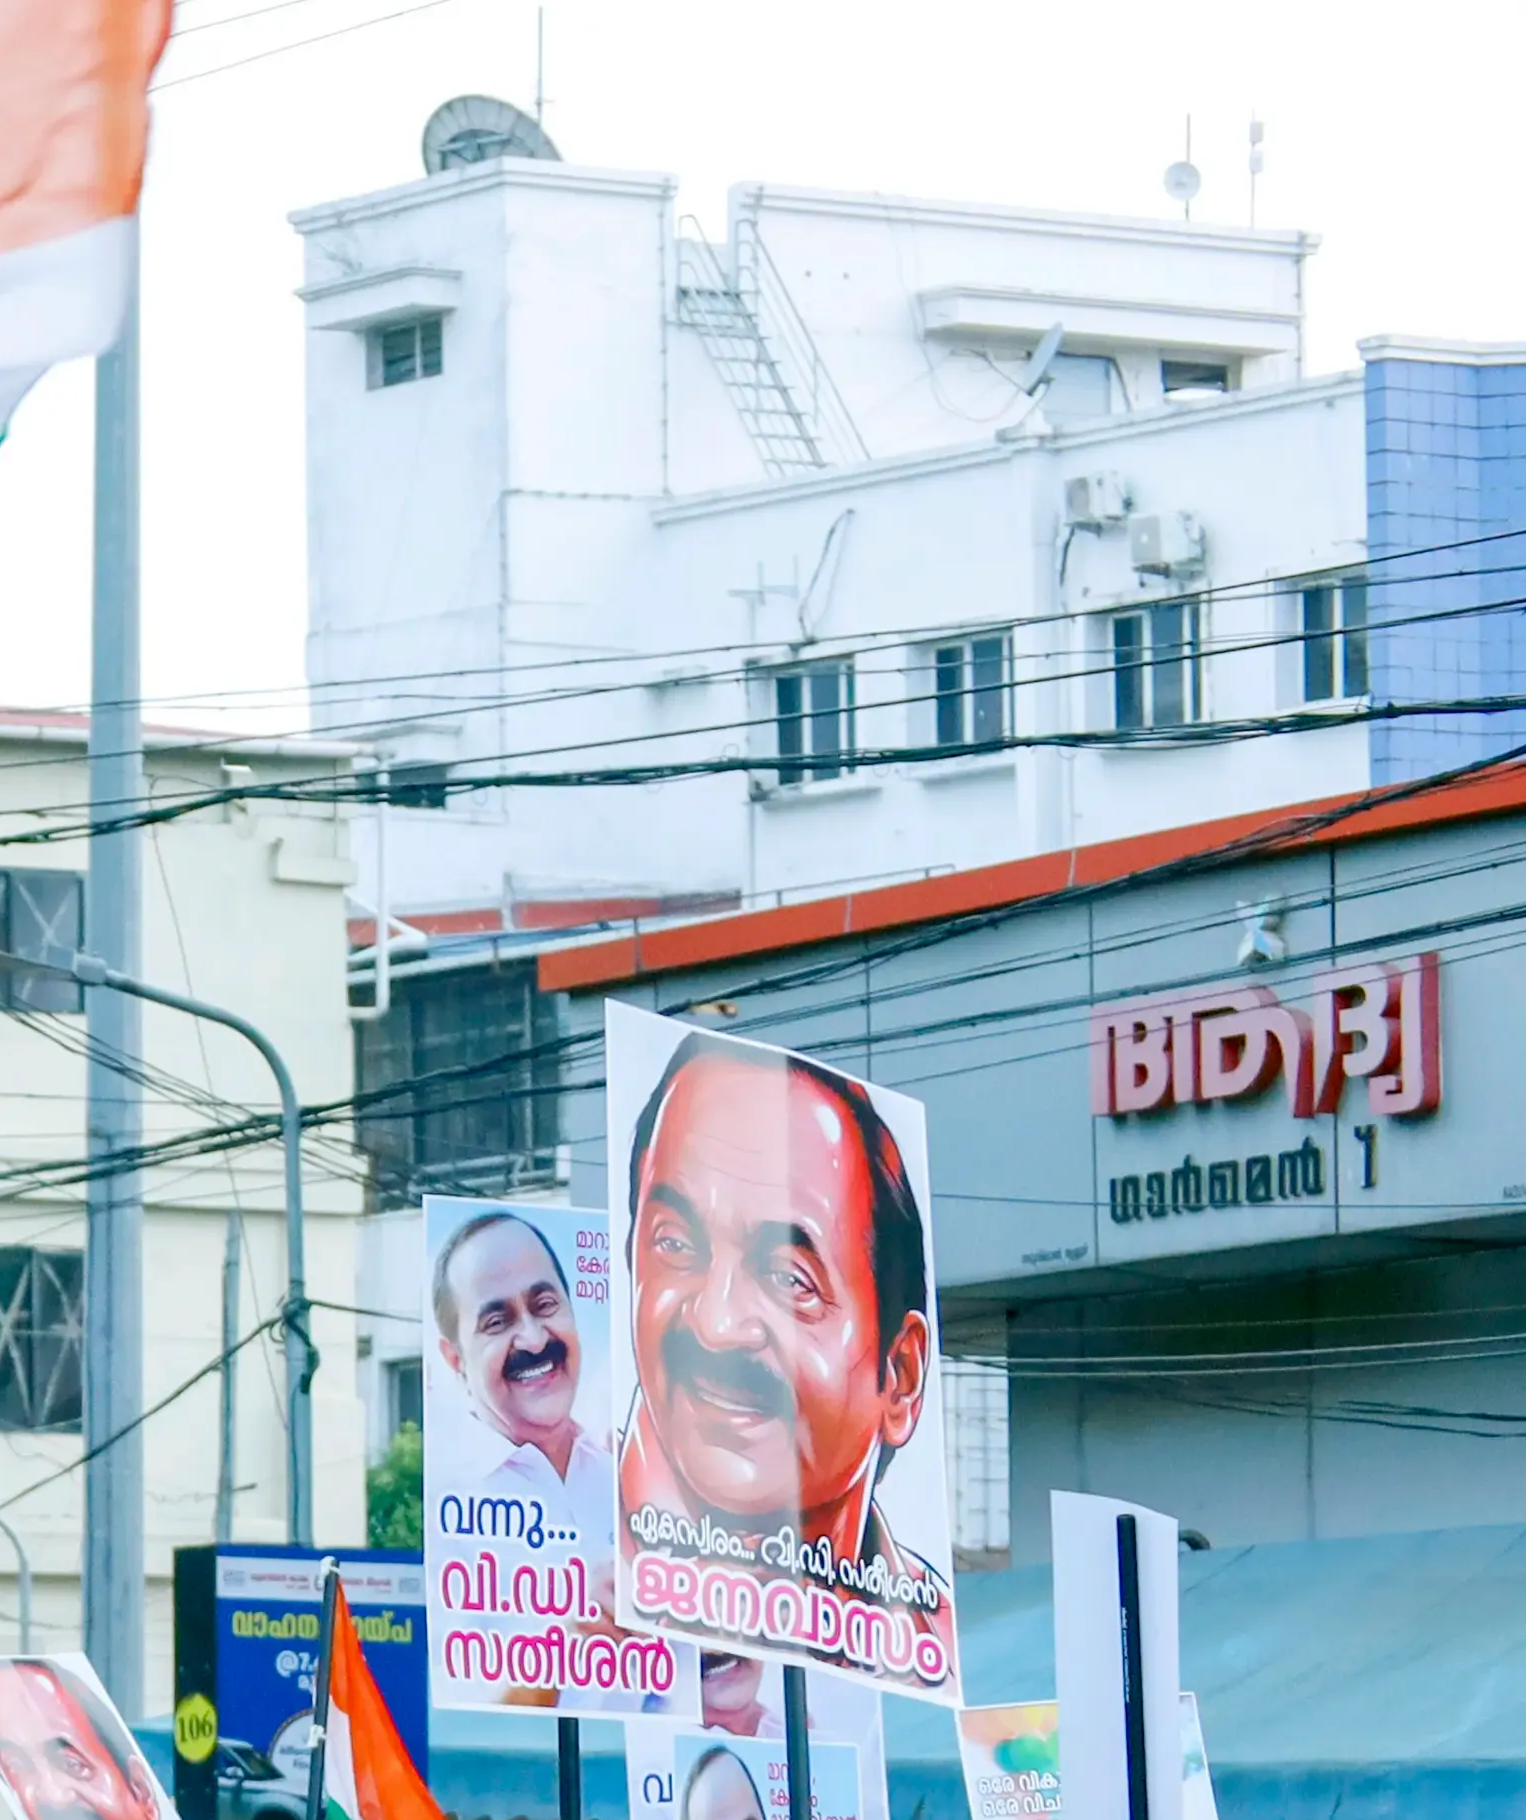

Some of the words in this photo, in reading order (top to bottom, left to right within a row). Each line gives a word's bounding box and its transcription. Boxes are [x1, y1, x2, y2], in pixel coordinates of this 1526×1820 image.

[440, 1492, 578, 1548] വന്നു...
[442, 1549, 599, 1620] വി.ഡി.
[630, 1505, 755, 1562] ഏകസ്വരം...
[760, 1525, 837, 1585] വി.ഡി.
[839, 1554, 939, 1611] സതീശൻ
[635, 1560, 945, 1676] ജനവാസം
[444, 1627, 675, 1695] സതീശൻ
[178, 1707, 213, 1743] 106
